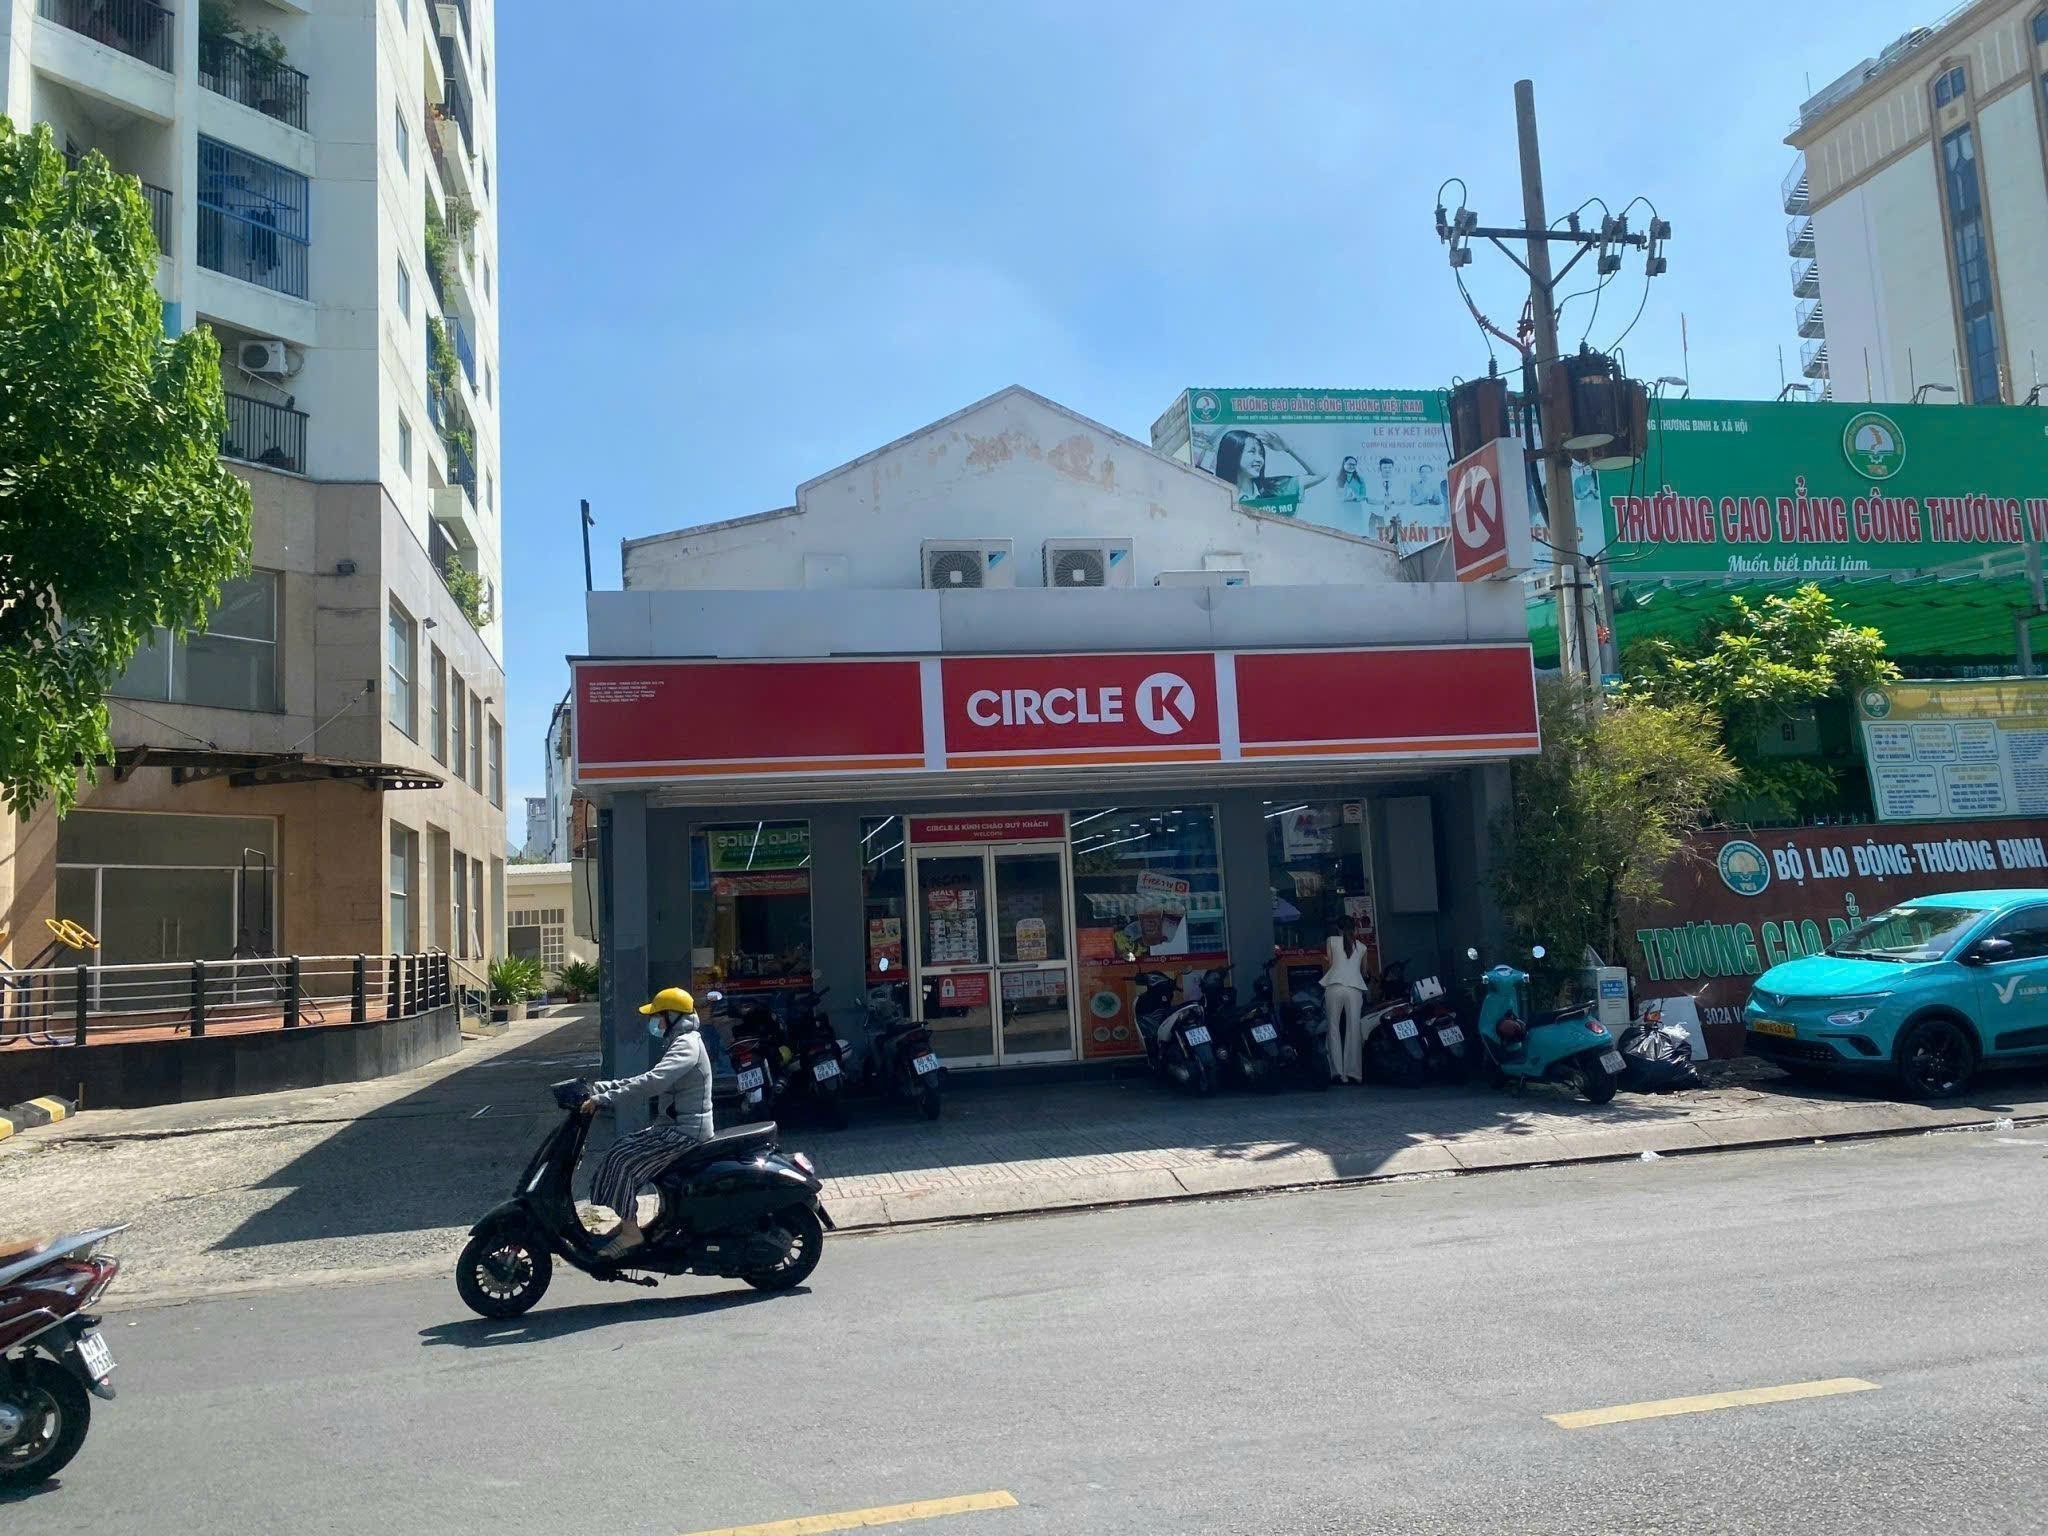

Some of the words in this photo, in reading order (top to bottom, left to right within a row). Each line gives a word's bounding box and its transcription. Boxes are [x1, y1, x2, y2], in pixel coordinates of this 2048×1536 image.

[1402, 399, 1424, 412] NAM
[1692, 420, 1712, 431] BINH
[1713, 422, 1720, 431] &
[1610, 484, 1715, 544] TRƯỜNG
[1719, 496, 1772, 544] CAO
[1777, 476, 1849, 544] ĐẲNG
[1853, 486, 1920, 544] CÔNG
[1924, 492, 2024, 544] THƯƠNG
[1728, 553, 1770, 572] Muốn
[1840, 554, 1870, 572] làm
[966, 687, 1124, 727] CIRCLE
[1151, 685, 1193, 731] K
[926, 824, 953, 832] CIRCLE
[1773, 842, 1804, 886] BỘ
[1807, 846, 1849, 879] LAO
[1997, 837, 2047, 870] BINH
[1704, 1007, 1733, 1025] 302A
